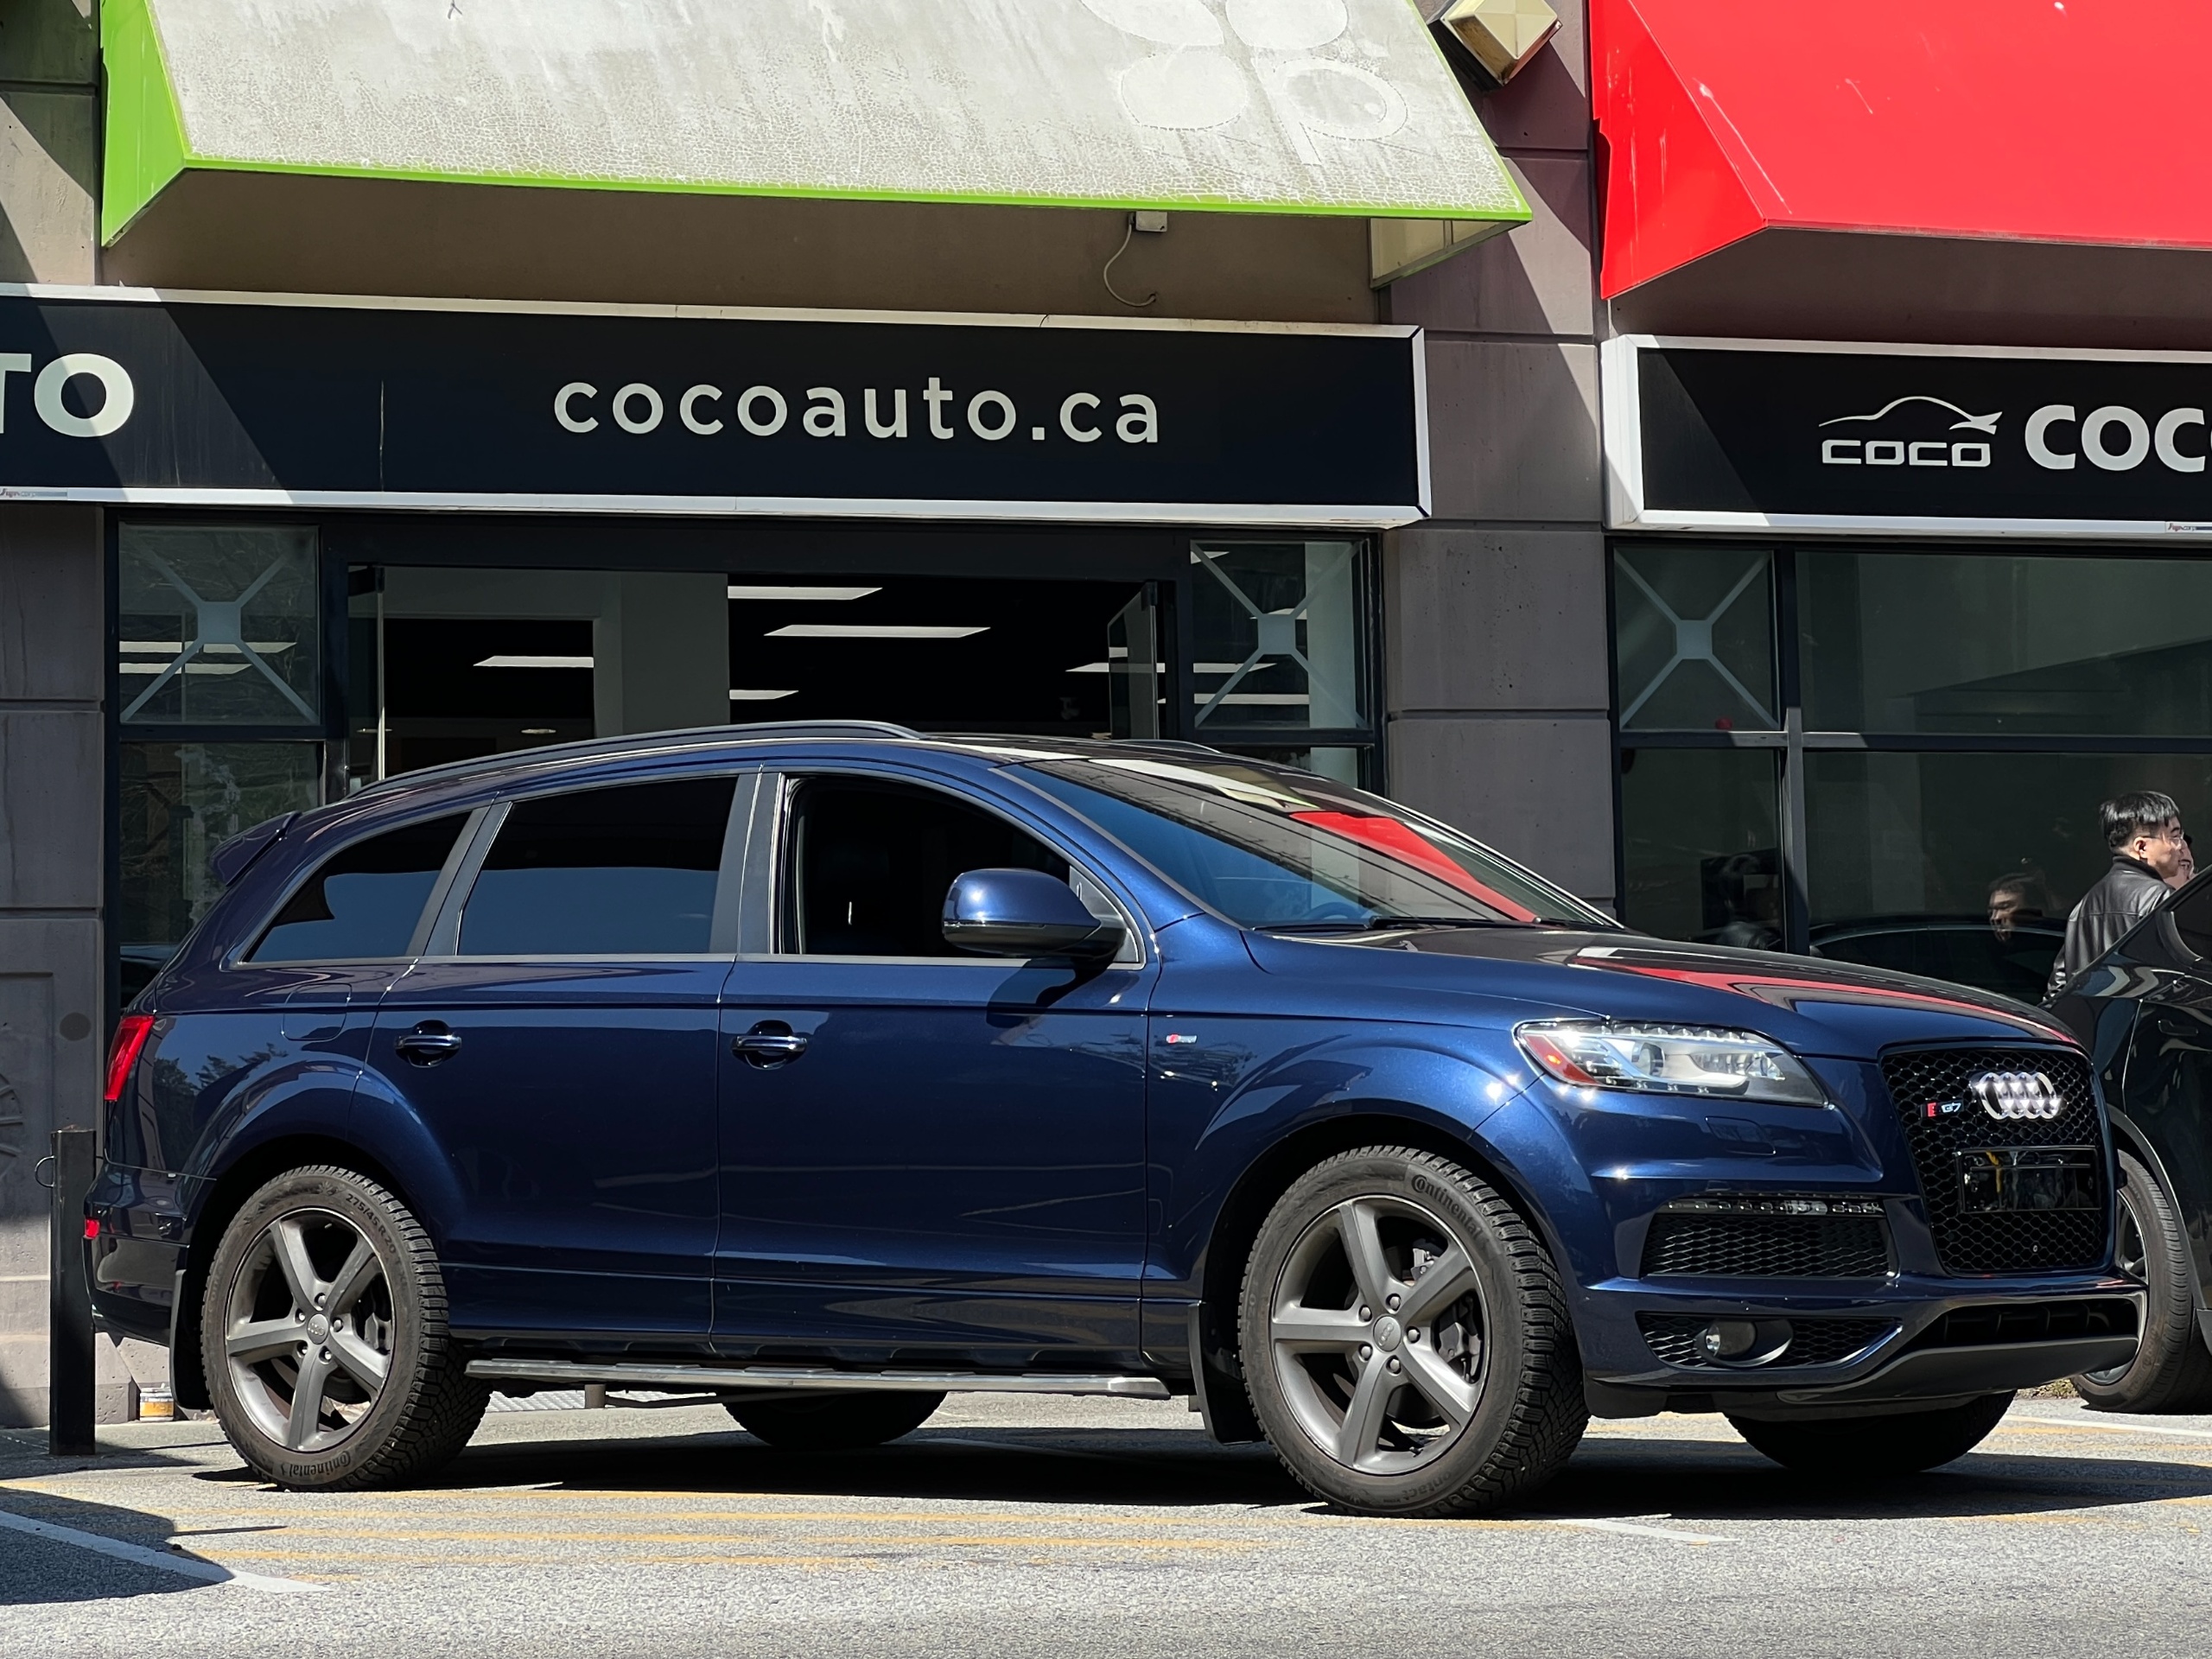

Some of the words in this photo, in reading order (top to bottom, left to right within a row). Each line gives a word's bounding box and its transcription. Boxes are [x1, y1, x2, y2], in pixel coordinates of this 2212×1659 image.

[553, 376, 1159, 443] cocoauto.ca
[1821, 439, 1991, 467] COCO
[2024, 404, 2212, 473] COC
[346, 1193, 380, 1226] 275/45
[1411, 1174, 1484, 1239] Continental
[289, 1450, 352, 1478] Continental
